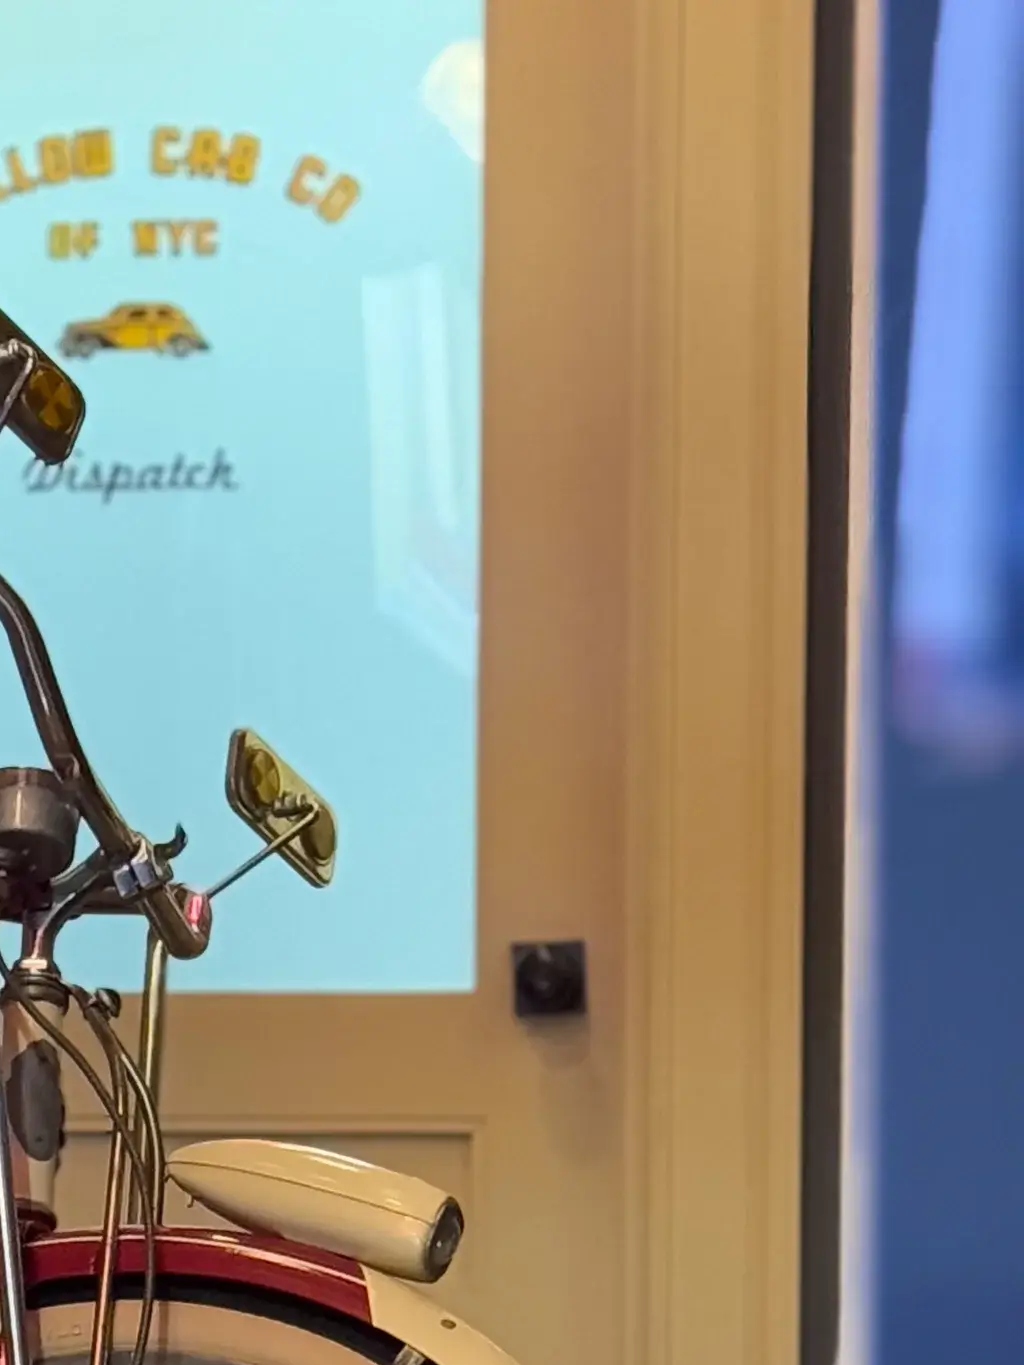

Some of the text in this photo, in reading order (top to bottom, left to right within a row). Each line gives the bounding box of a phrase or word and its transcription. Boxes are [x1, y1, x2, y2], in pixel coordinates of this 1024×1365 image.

[150, 126, 260, 184] CAB
[285, 154, 362, 223] CO
[47, 219, 219, 260] OF NYC
[22, 447, 238, 504] Dispatch
